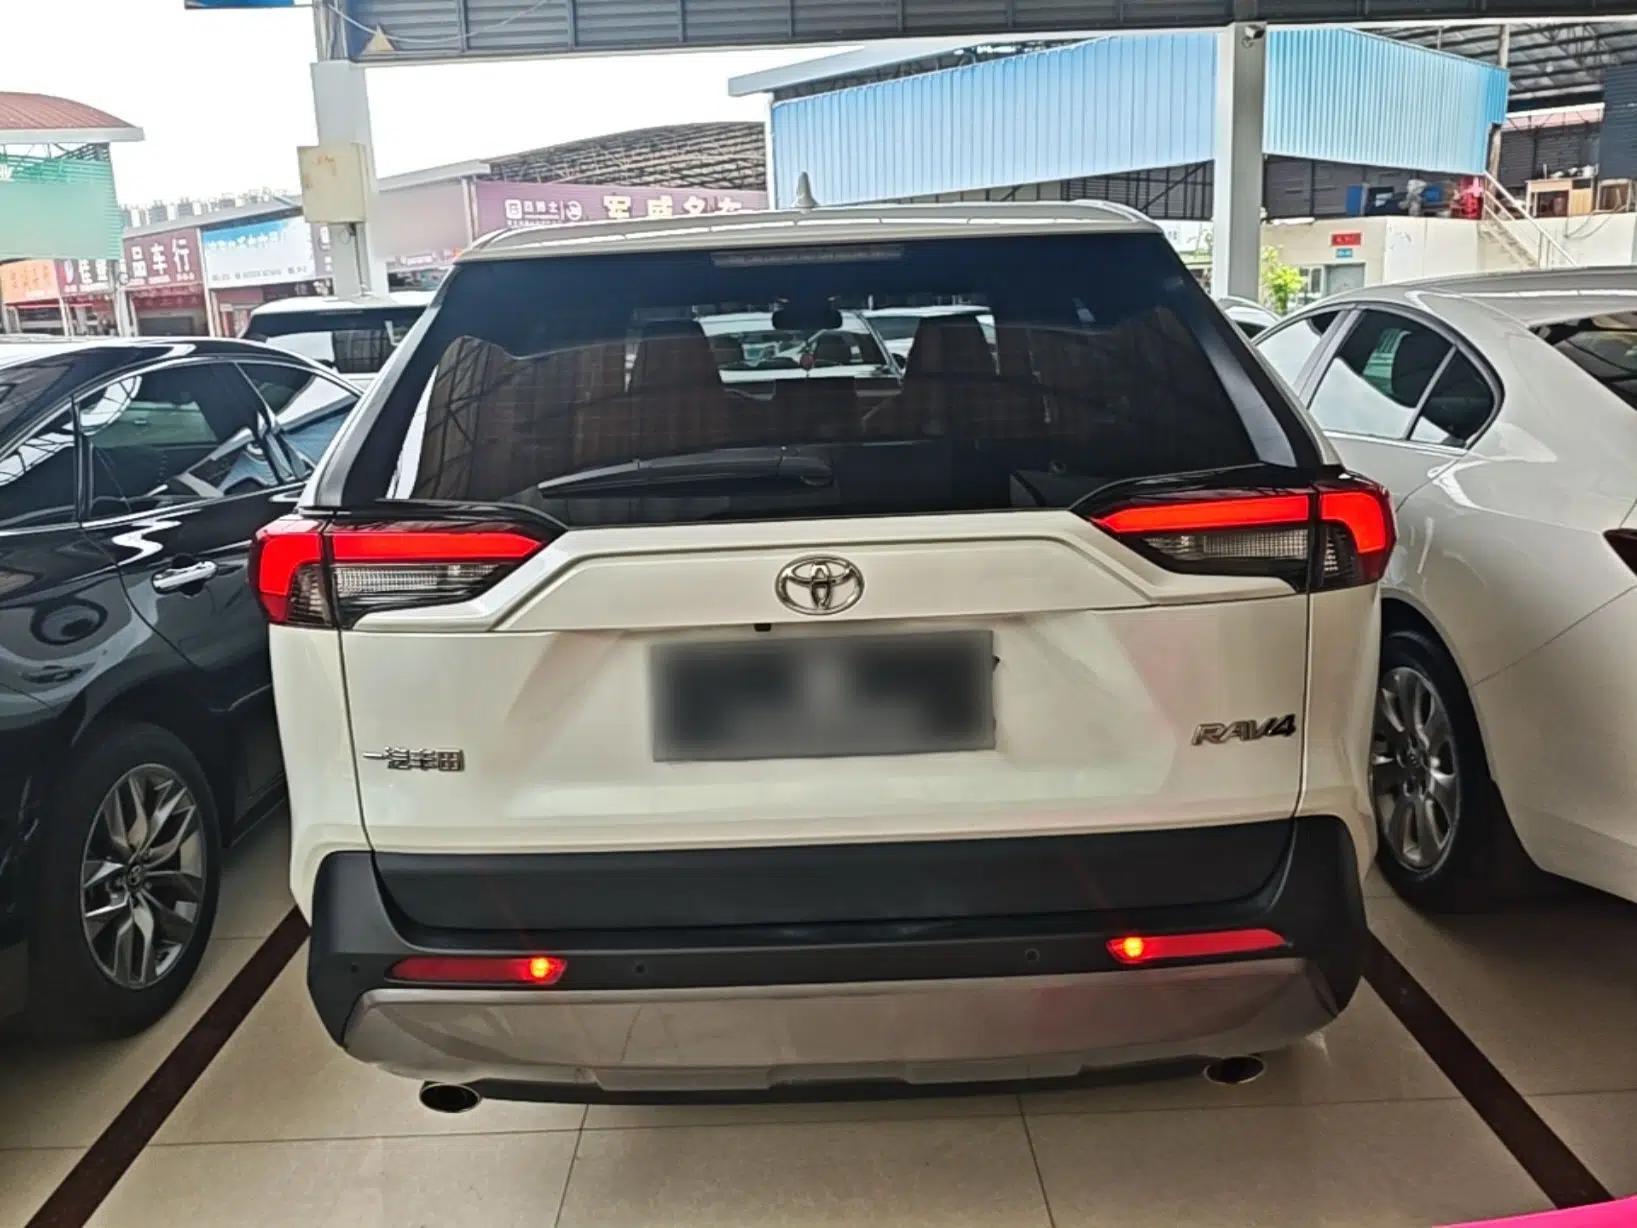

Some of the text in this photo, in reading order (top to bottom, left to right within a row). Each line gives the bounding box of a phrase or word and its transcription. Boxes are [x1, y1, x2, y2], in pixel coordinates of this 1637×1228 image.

[1191, 713, 1297, 746] RAV4
[362, 746, 465, 772] 一汽丰田
